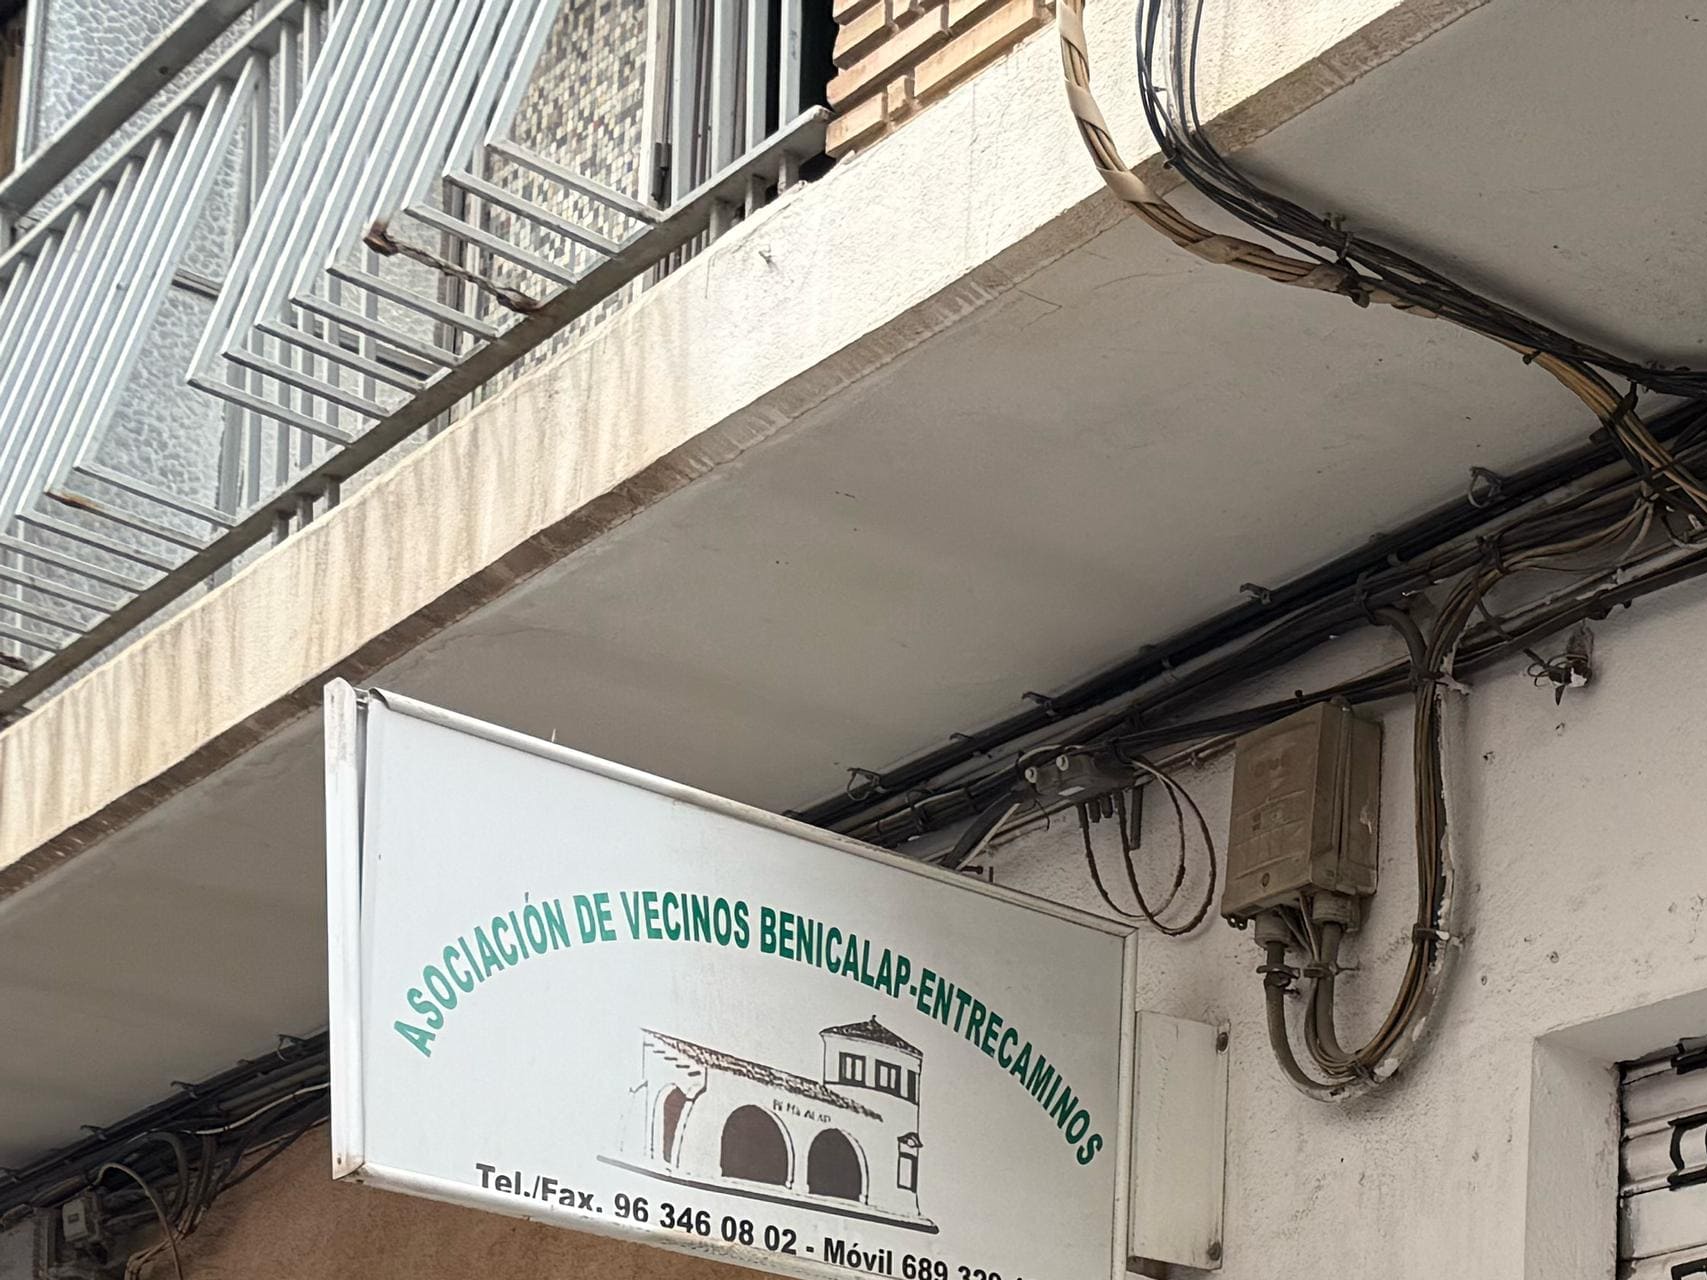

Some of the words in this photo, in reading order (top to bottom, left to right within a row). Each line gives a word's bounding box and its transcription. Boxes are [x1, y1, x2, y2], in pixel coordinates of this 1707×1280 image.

[393, 892, 570, 1058] ASOCIACIÓN
[576, 891, 617, 945] DE
[621, 891, 751, 951] VECINOS
[759, 906, 1104, 1168] BENICALAP-ENTRECAMINOS
[475, 1161, 604, 1214] Tel./Fax.
[614, 1193, 650, 1223] 96
[659, 1202, 712, 1238] 346
[721, 1215, 755, 1247] 08
[764, 1225, 798, 1256] 02
[823, 1236, 894, 1277] Móvil
